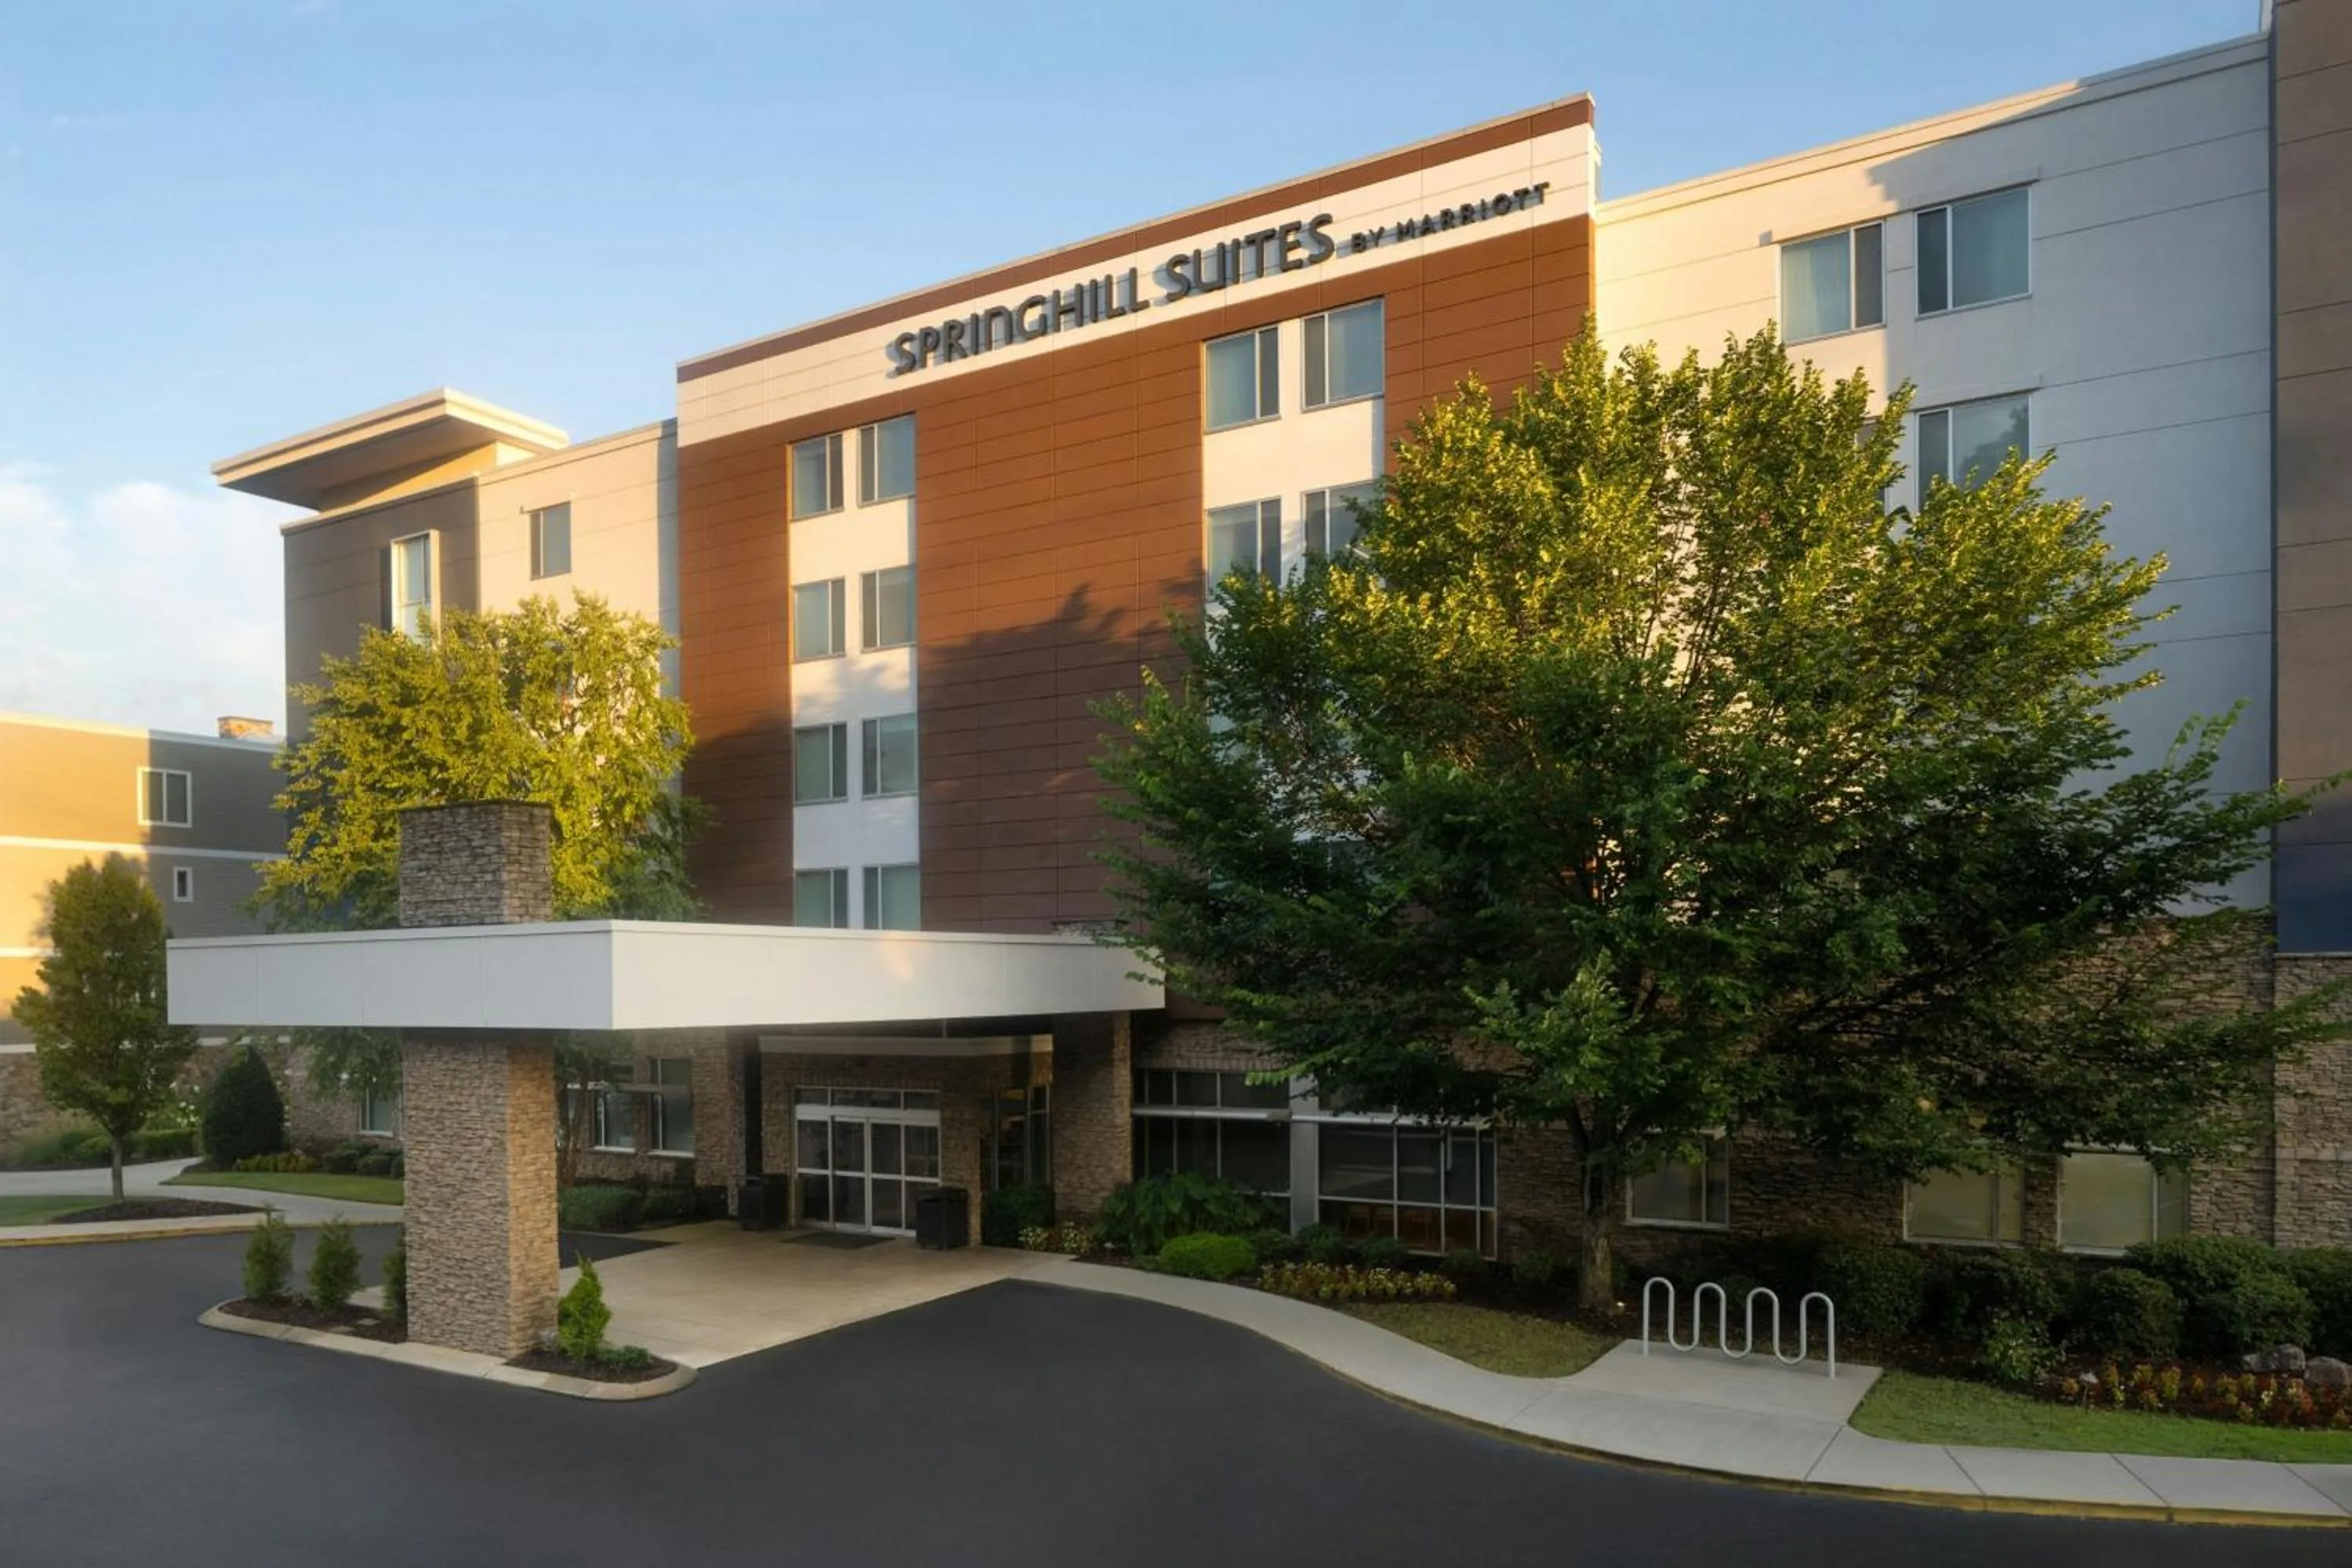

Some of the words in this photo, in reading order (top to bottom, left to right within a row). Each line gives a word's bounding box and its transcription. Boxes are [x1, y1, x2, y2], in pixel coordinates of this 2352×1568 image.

[895, 267, 1150, 376] SPRINGHILL
[1166, 212, 1335, 303] SUITES
[1351, 226, 1385, 253] BY
[1396, 181, 1551, 241] MARRIOTT
